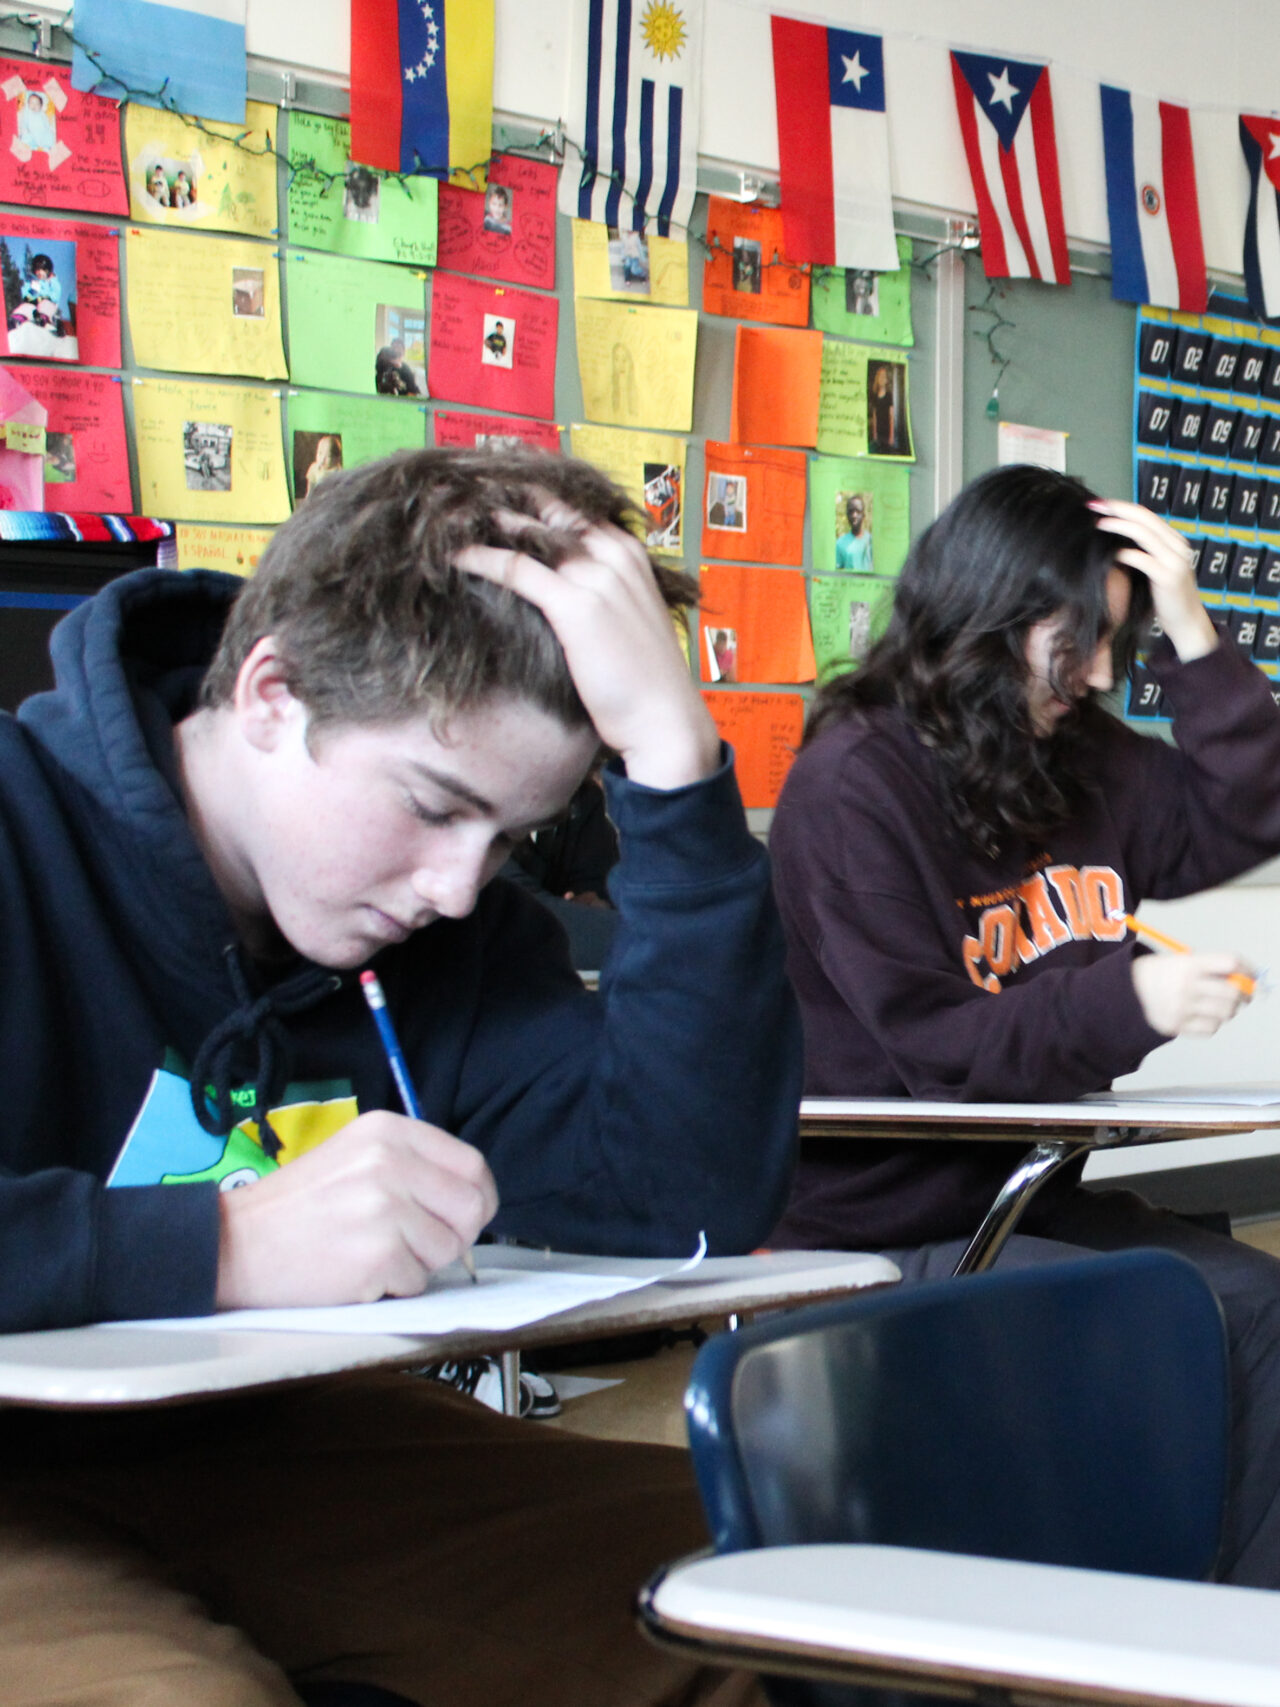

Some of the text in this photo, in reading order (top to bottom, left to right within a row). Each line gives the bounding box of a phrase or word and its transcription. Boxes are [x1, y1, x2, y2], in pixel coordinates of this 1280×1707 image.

[1151, 339, 1169, 363] 01
[1183, 347, 1203, 371] 02
[1216, 354, 1236, 378] 03
[1244, 358, 1263, 381] 04
[1150, 407, 1170, 431] 07
[1182, 414, 1200, 438] 08
[1211, 419, 1232, 443] 09
[1244, 426, 1261, 449] 10
[1151, 476, 1169, 500] 13
[1184, 481, 1198, 505] 14
[1211, 486, 1229, 510] 15
[1240, 490, 1257, 514] 16
[1209, 552, 1227, 574] 21
[1238, 555, 1258, 579] 22
[1237, 621, 1257, 644] 28
[1139, 683, 1162, 705] 31
